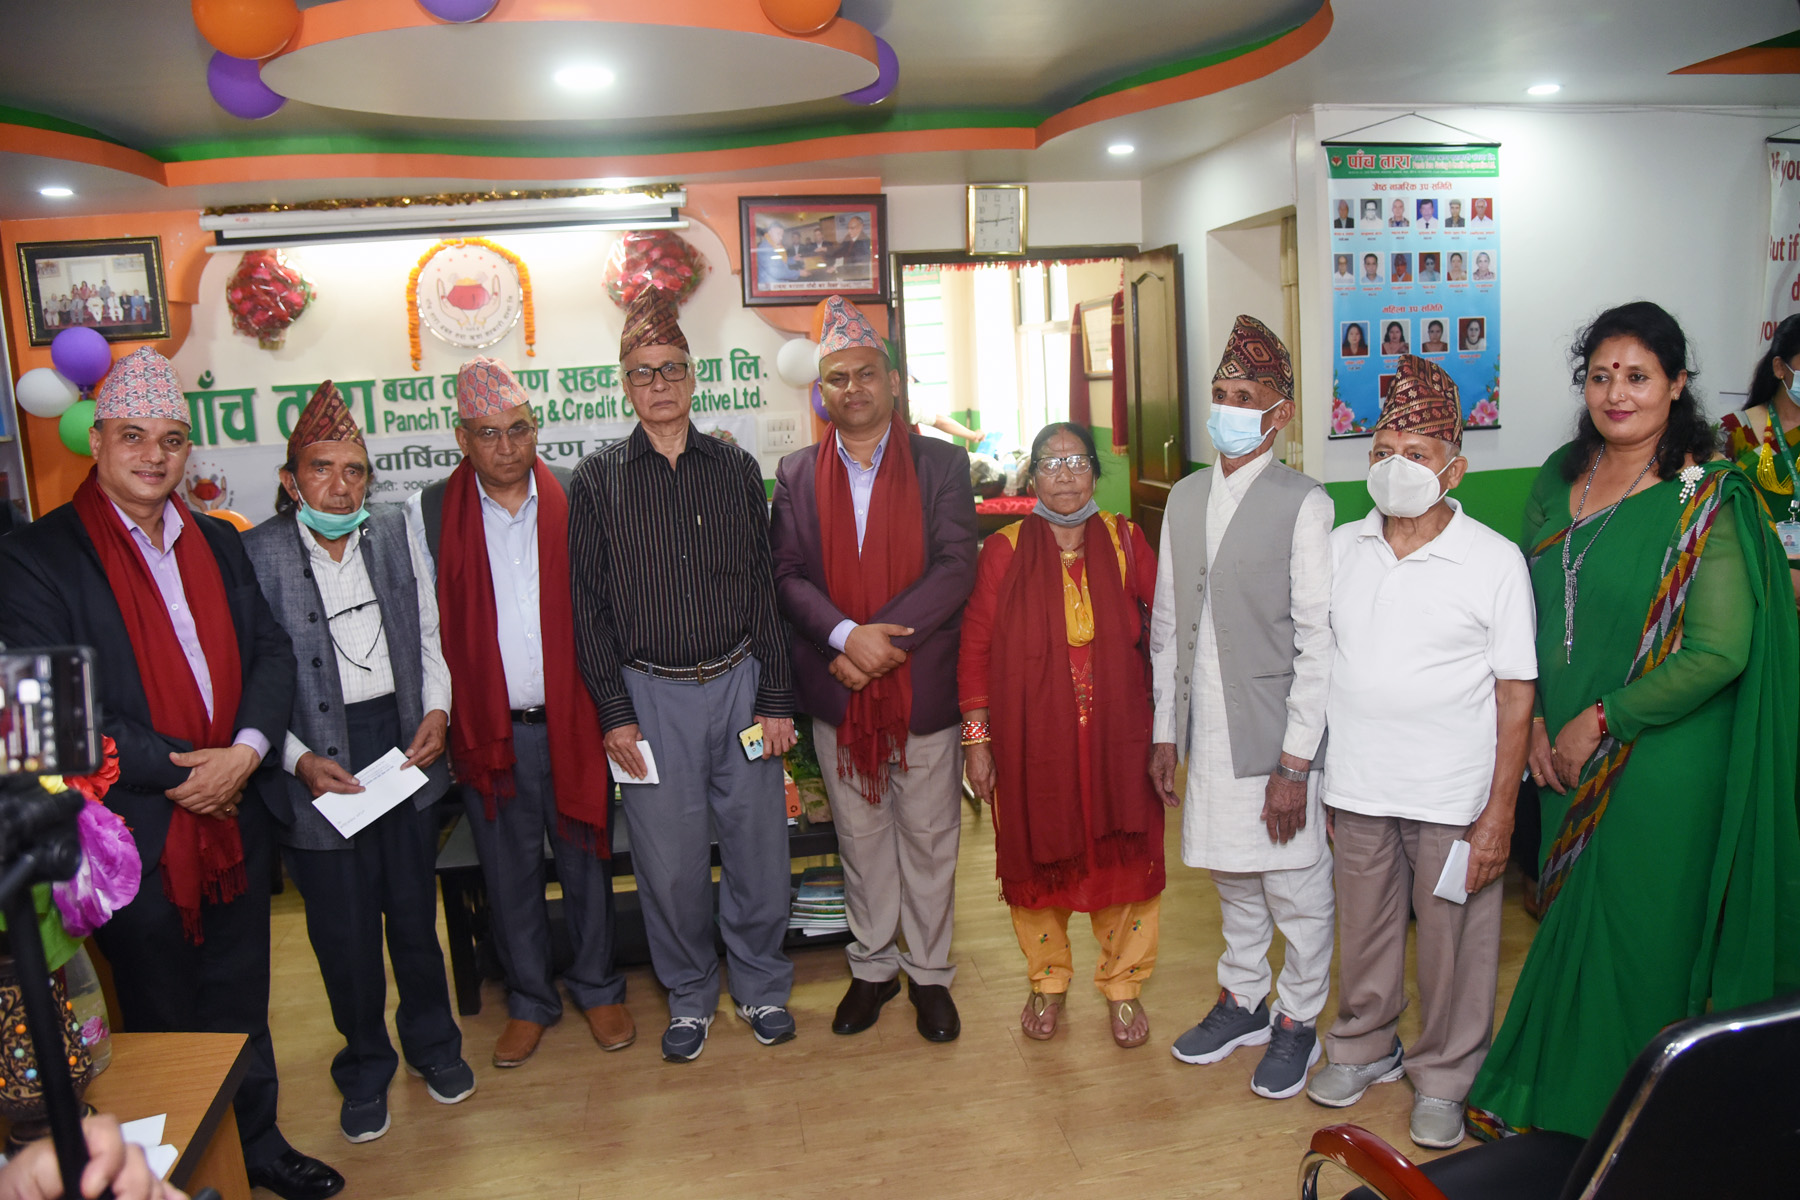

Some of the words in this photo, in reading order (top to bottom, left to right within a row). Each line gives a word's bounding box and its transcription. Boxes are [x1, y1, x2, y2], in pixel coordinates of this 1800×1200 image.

[1347, 149, 1376, 169] पाँच
[1379, 154, 1411, 169] तारा
[1770, 235, 1785, 261] ut
[382, 376, 434, 402] बचत
[730, 348, 767, 381] लि.
[384, 407, 438, 433] Panch
[441, 405, 461, 429] Ta
[375, 445, 462, 472] वार्षिक
